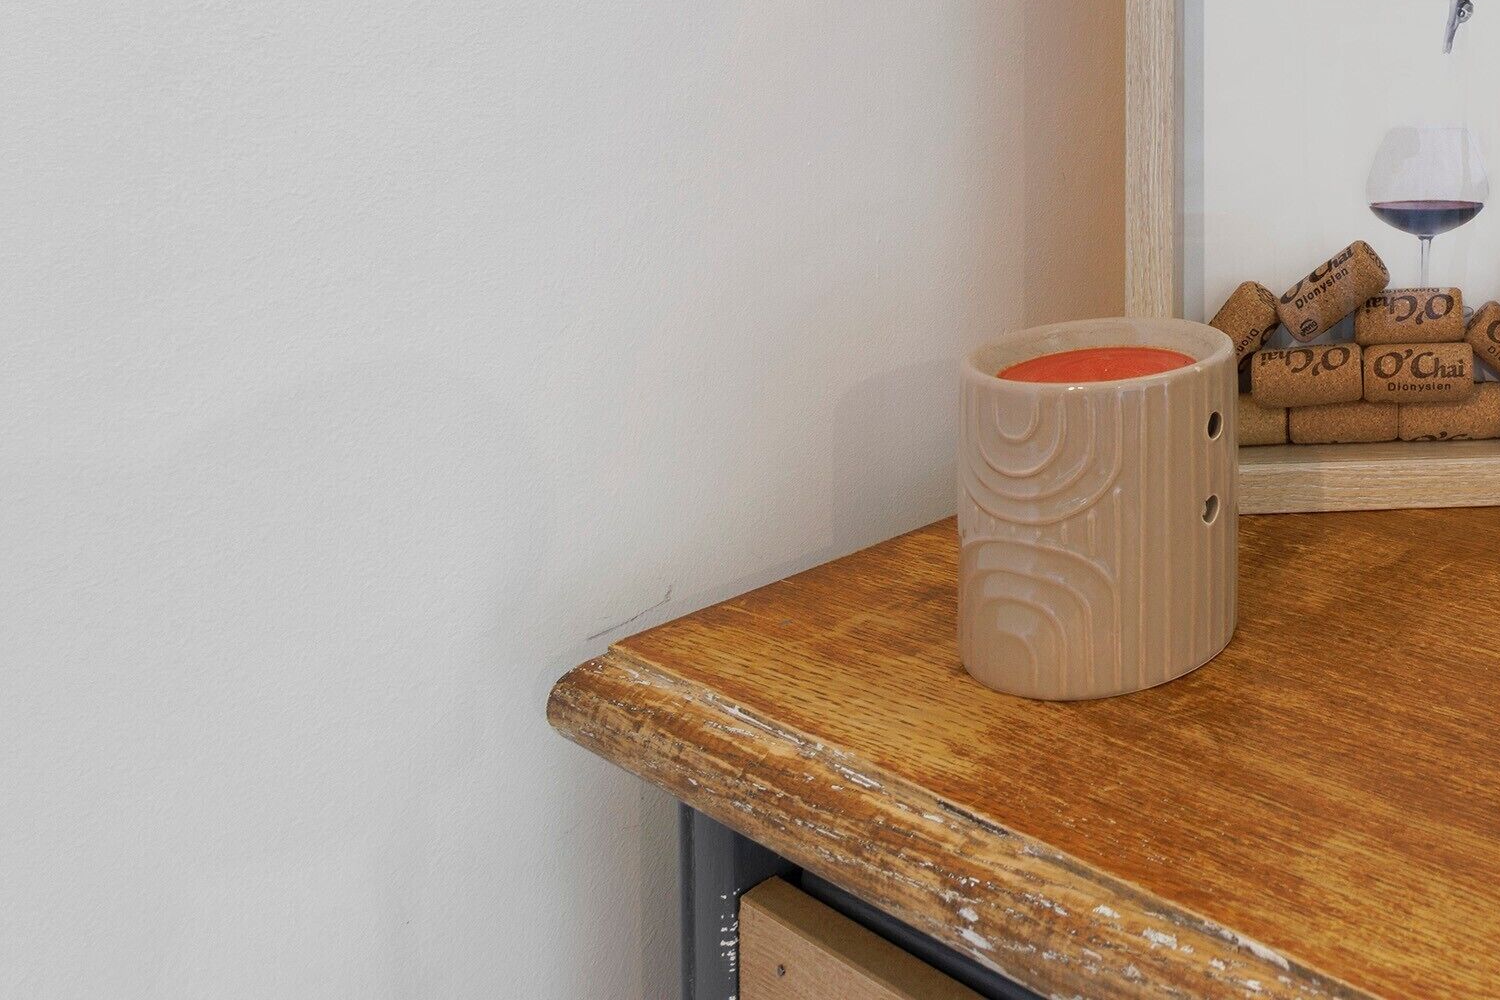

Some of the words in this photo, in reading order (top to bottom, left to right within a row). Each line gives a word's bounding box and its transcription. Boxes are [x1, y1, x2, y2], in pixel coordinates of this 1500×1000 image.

[1294, 267, 1349, 310] Dionysien
[1365, 293, 1455, 325] O'Chai
[1260, 348, 1350, 377] O'Chai
[1373, 349, 1465, 379] O'Chai
[1387, 382, 1451, 392] Dionysien
